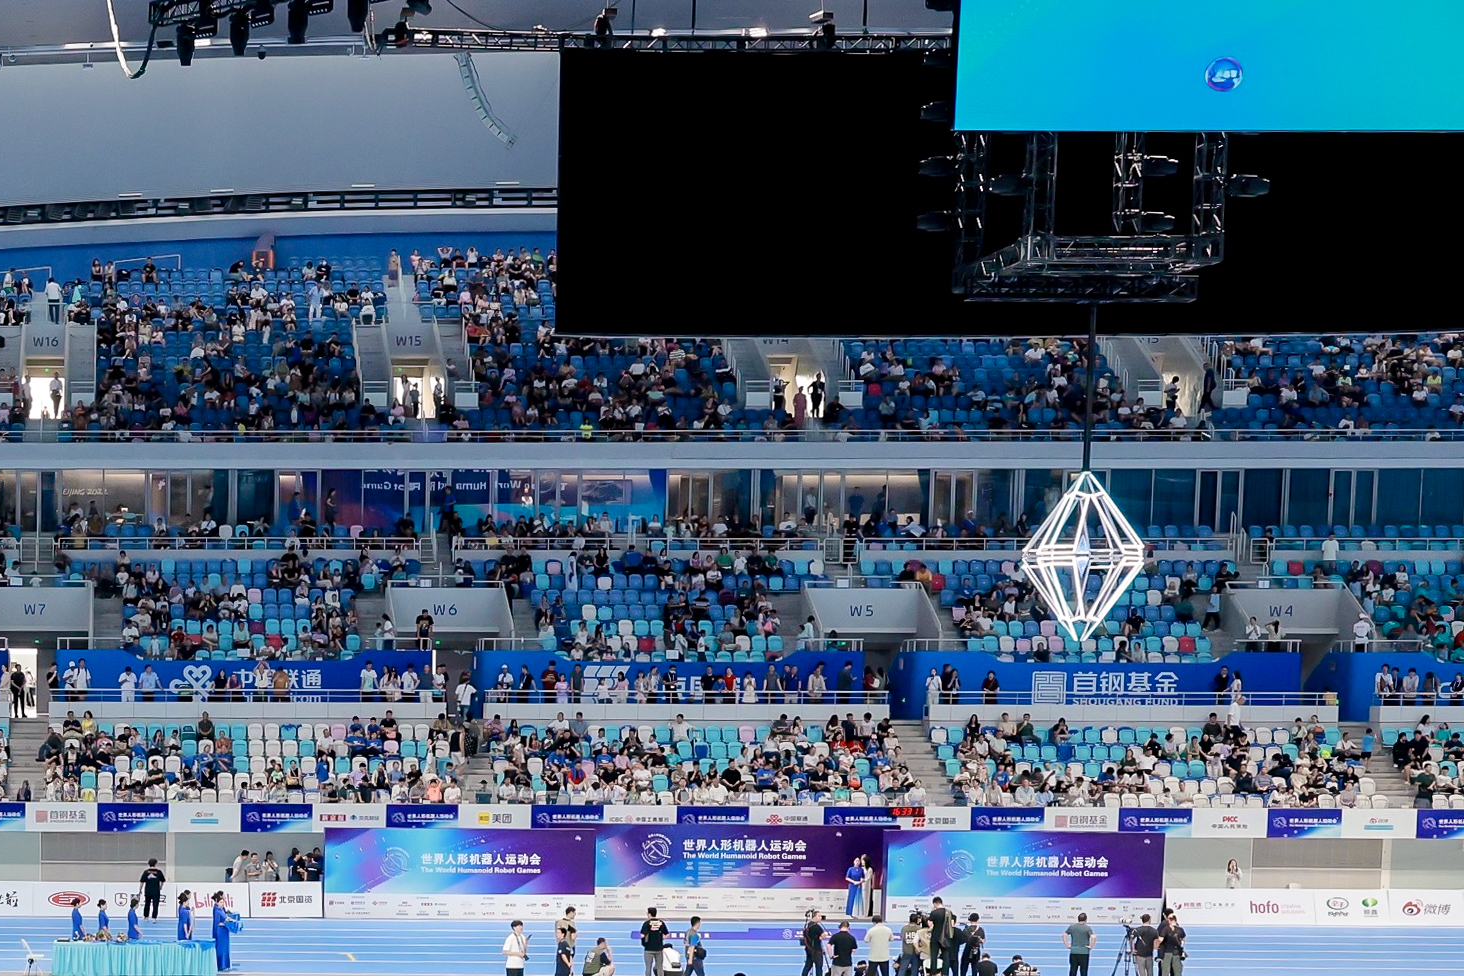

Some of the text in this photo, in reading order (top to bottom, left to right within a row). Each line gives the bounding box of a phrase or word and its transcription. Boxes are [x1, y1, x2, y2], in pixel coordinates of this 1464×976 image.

[33, 336, 58, 347] W16
[396, 335, 421, 346] W15
[24, 603, 46, 615] W7
[433, 604, 457, 616] W6
[850, 605, 873, 617] W5
[1270, 605, 1293, 617] W4
[233, 668, 322, 690] 中联通
[1073, 671, 1179, 695] 首钢基金
[1073, 698, 1141, 706] SHOUGANG
[492, 813, 513, 824] 美团
[683, 839, 807, 852] 世界人形机器人运动会
[421, 853, 541, 866] 世界人形机器人运动会
[986, 856, 1108, 869] 世界人形机器人运动会
[279, 894, 313, 904] 北京国资
[1250, 901, 1279, 914] hofo
